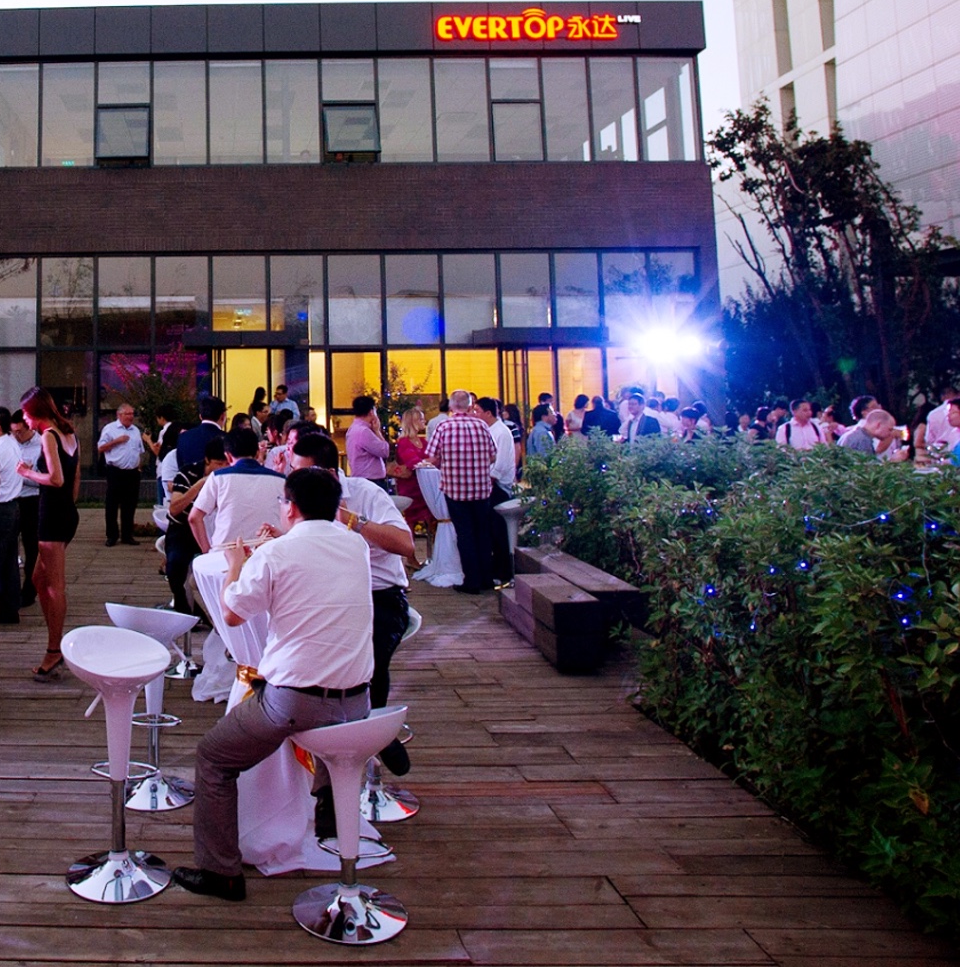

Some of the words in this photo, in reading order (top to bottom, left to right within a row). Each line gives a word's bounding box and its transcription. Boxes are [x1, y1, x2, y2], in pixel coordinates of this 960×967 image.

[437, 16, 564, 39] EVERTOP
[567, 14, 618, 39] 永达
[617, 15, 641, 23] LIVE
